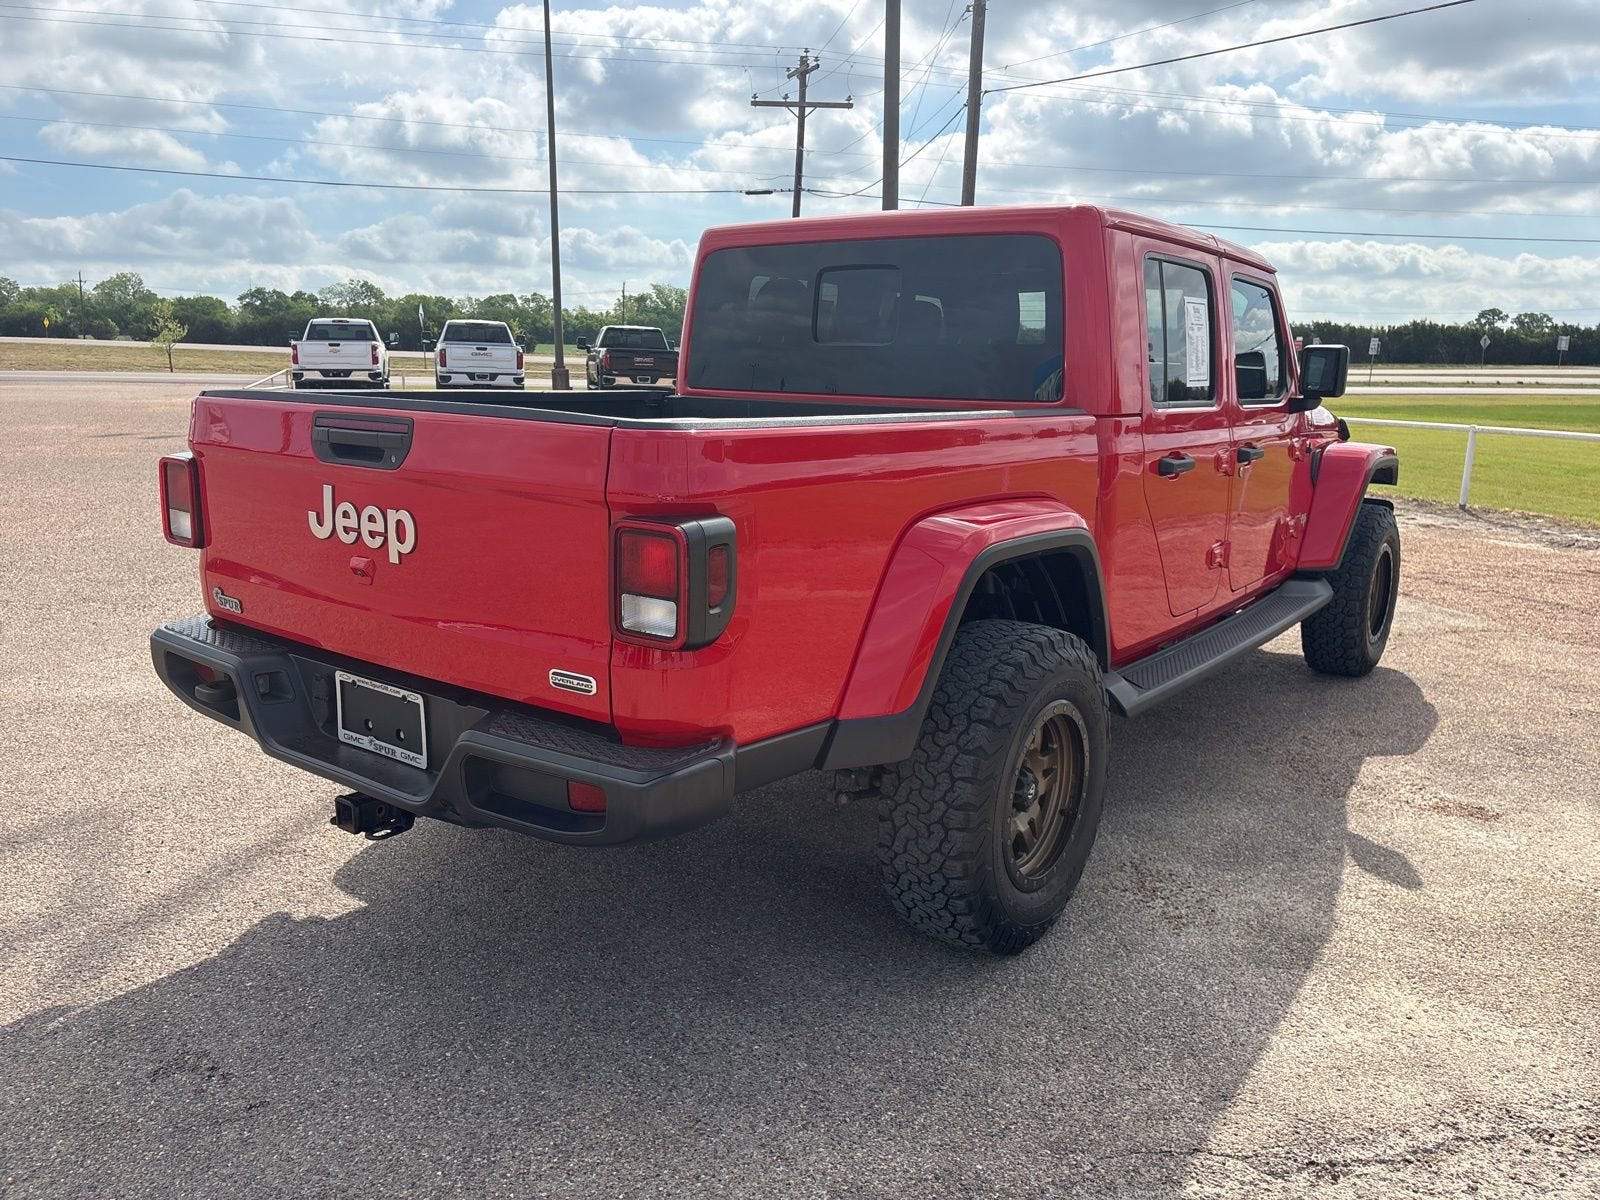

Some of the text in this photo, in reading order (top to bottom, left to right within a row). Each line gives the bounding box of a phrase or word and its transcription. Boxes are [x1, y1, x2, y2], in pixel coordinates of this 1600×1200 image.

[308, 484, 417, 565] Jeep
[218, 596, 241, 611] SPUR
[551, 675, 593, 689] OVERLAND
[343, 733, 422, 765] GMC SPUR GMC
